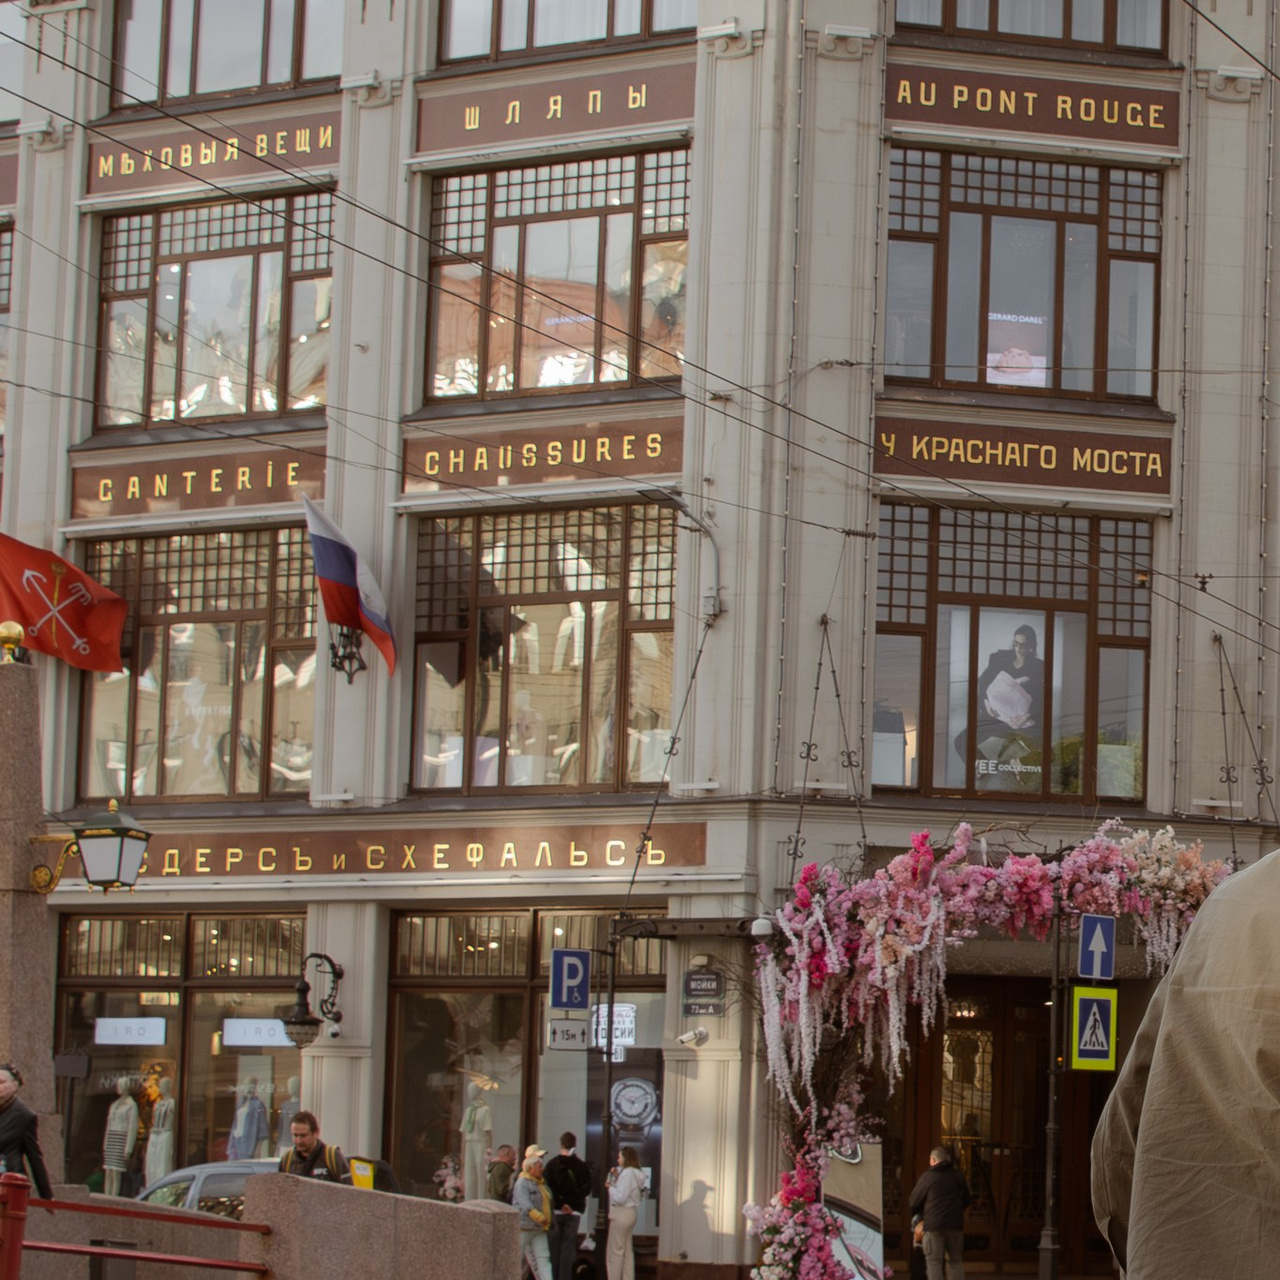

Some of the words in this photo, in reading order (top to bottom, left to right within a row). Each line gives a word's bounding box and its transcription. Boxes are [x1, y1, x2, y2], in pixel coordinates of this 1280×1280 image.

[464, 83, 647, 131] ШЛЯПЫ
[897, 79, 937, 107] AU
[953, 84, 1038, 116] PONT
[1056, 94, 1166, 129] ROUGE
[255, 124, 334, 158] ВЕЩИ
[424, 432, 663, 475] CHAUSSURES
[911, 434, 1058, 470] КРАСНАГО
[1072, 447, 1163, 478] МОСТА
[365, 839, 667, 870] СХЕФАЛЬСЪ
[561, 955, 585, 1003] P
[113, 1026, 147, 1037] IRO
